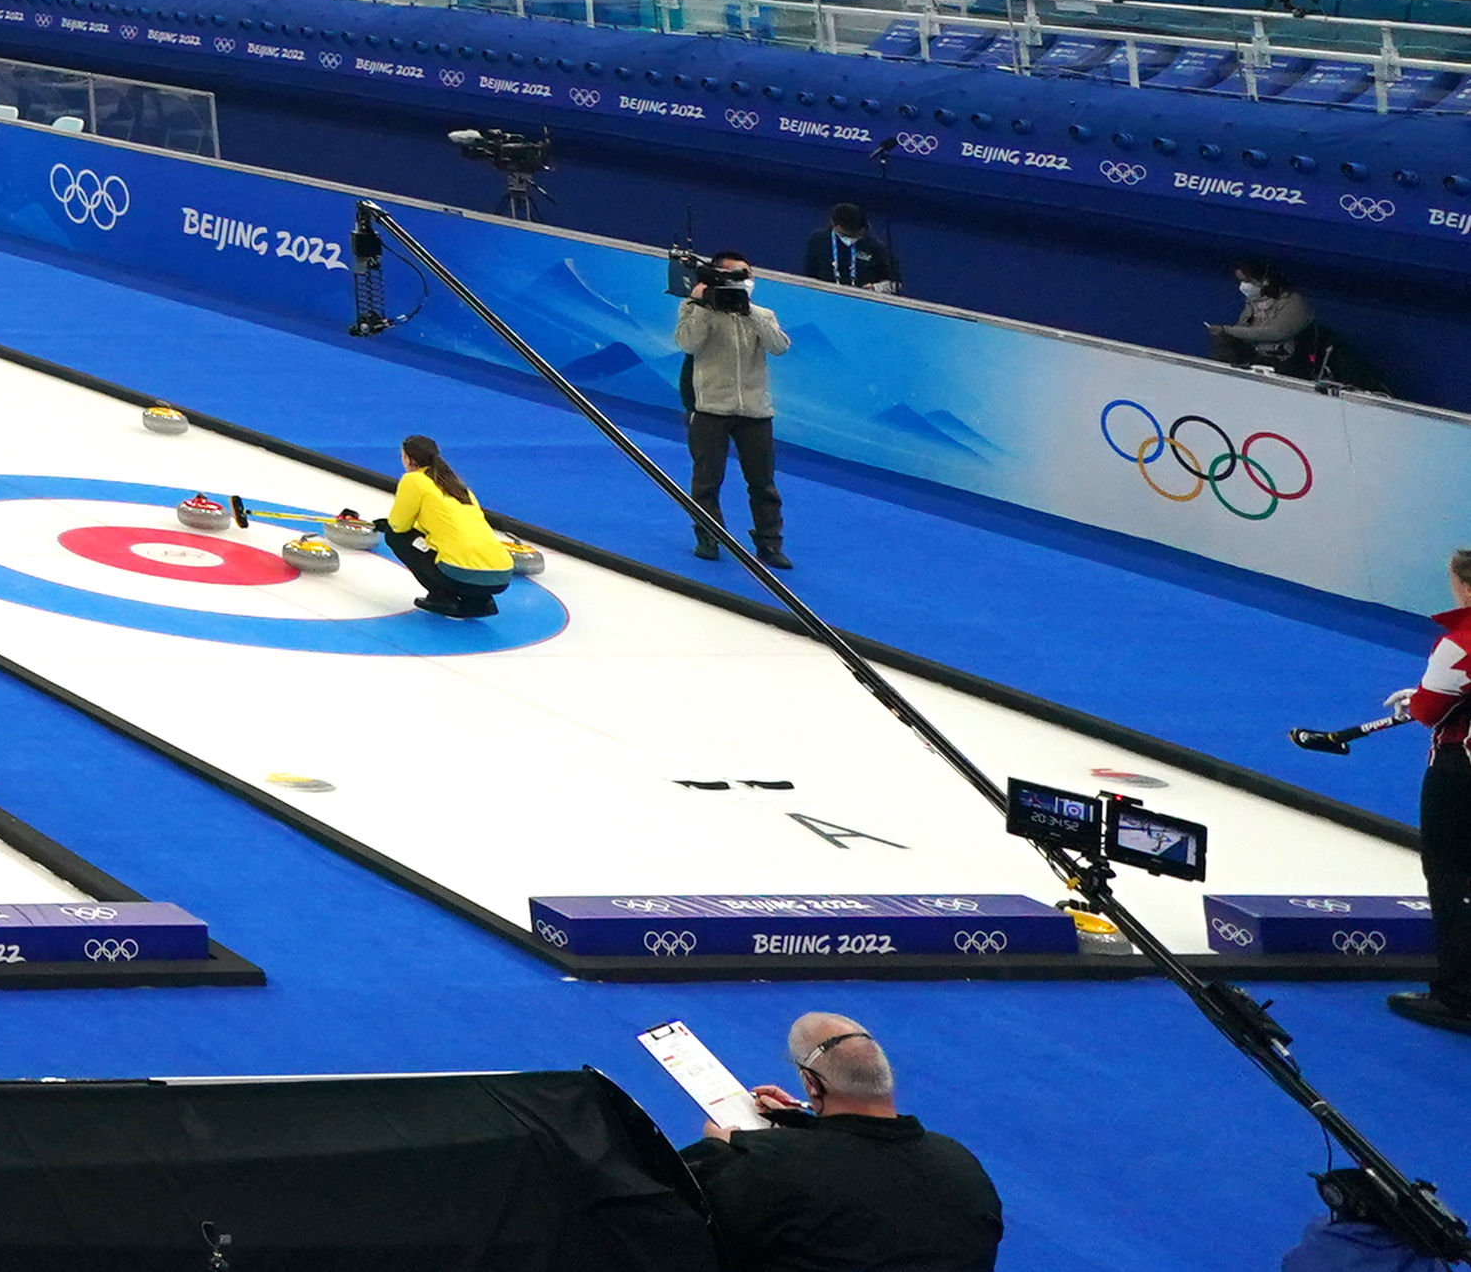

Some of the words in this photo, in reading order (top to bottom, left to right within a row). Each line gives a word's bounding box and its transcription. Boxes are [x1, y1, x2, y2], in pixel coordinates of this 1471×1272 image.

[148, 29, 177, 43] BEIJING
[179, 35, 201, 45] 2022
[248, 43, 280, 57] BEIJING
[282, 48, 305, 60] 2022
[356, 58, 393, 75] BEIJING
[396, 65, 424, 78] 2022
[480, 76, 519, 93] BEIJING
[522, 83, 551, 96] 2022
[620, 96, 667, 115] BEIJING
[671, 104, 705, 118] 2022
[780, 118, 829, 138] BEIJING
[834, 126, 871, 141] 2022
[962, 143, 1020, 164] BEIJING
[1024, 152, 1071, 170] 2022
[1174, 173, 1243, 197] BEIJING
[1249, 184, 1306, 204] 2022
[1429, 209, 1471, 234] BEIJ
[182, 208, 268, 255] BEIJING
[276, 231, 348, 270] 2022
[785, 813, 909, 849] A
[720, 900, 800, 913] BEIJING
[801, 900, 870, 911] 2022
[753, 934, 830, 955] BEIJING
[837, 934, 896, 954] 2022
